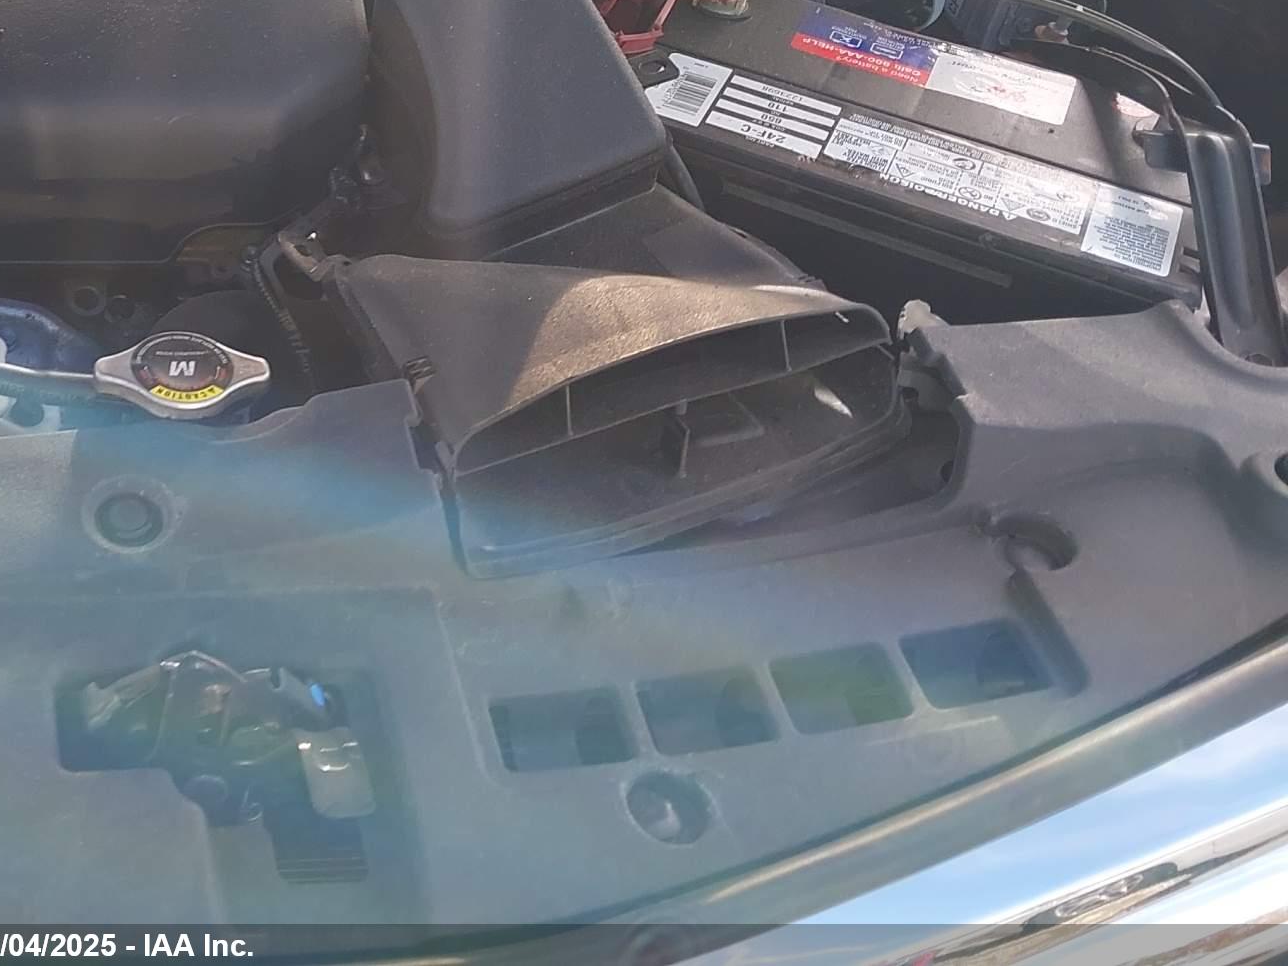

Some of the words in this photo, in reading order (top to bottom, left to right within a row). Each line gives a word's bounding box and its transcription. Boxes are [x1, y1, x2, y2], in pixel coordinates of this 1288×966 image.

[801, 36, 891, 67] 800-AAA-HELP
[834, 53, 879, 71] battery?
[889, 69, 918, 82] Need
[739, 123, 786, 144] 24F-C
[168, 359, 195, 376] M
[156, 387, 207, 400] CAUTION
